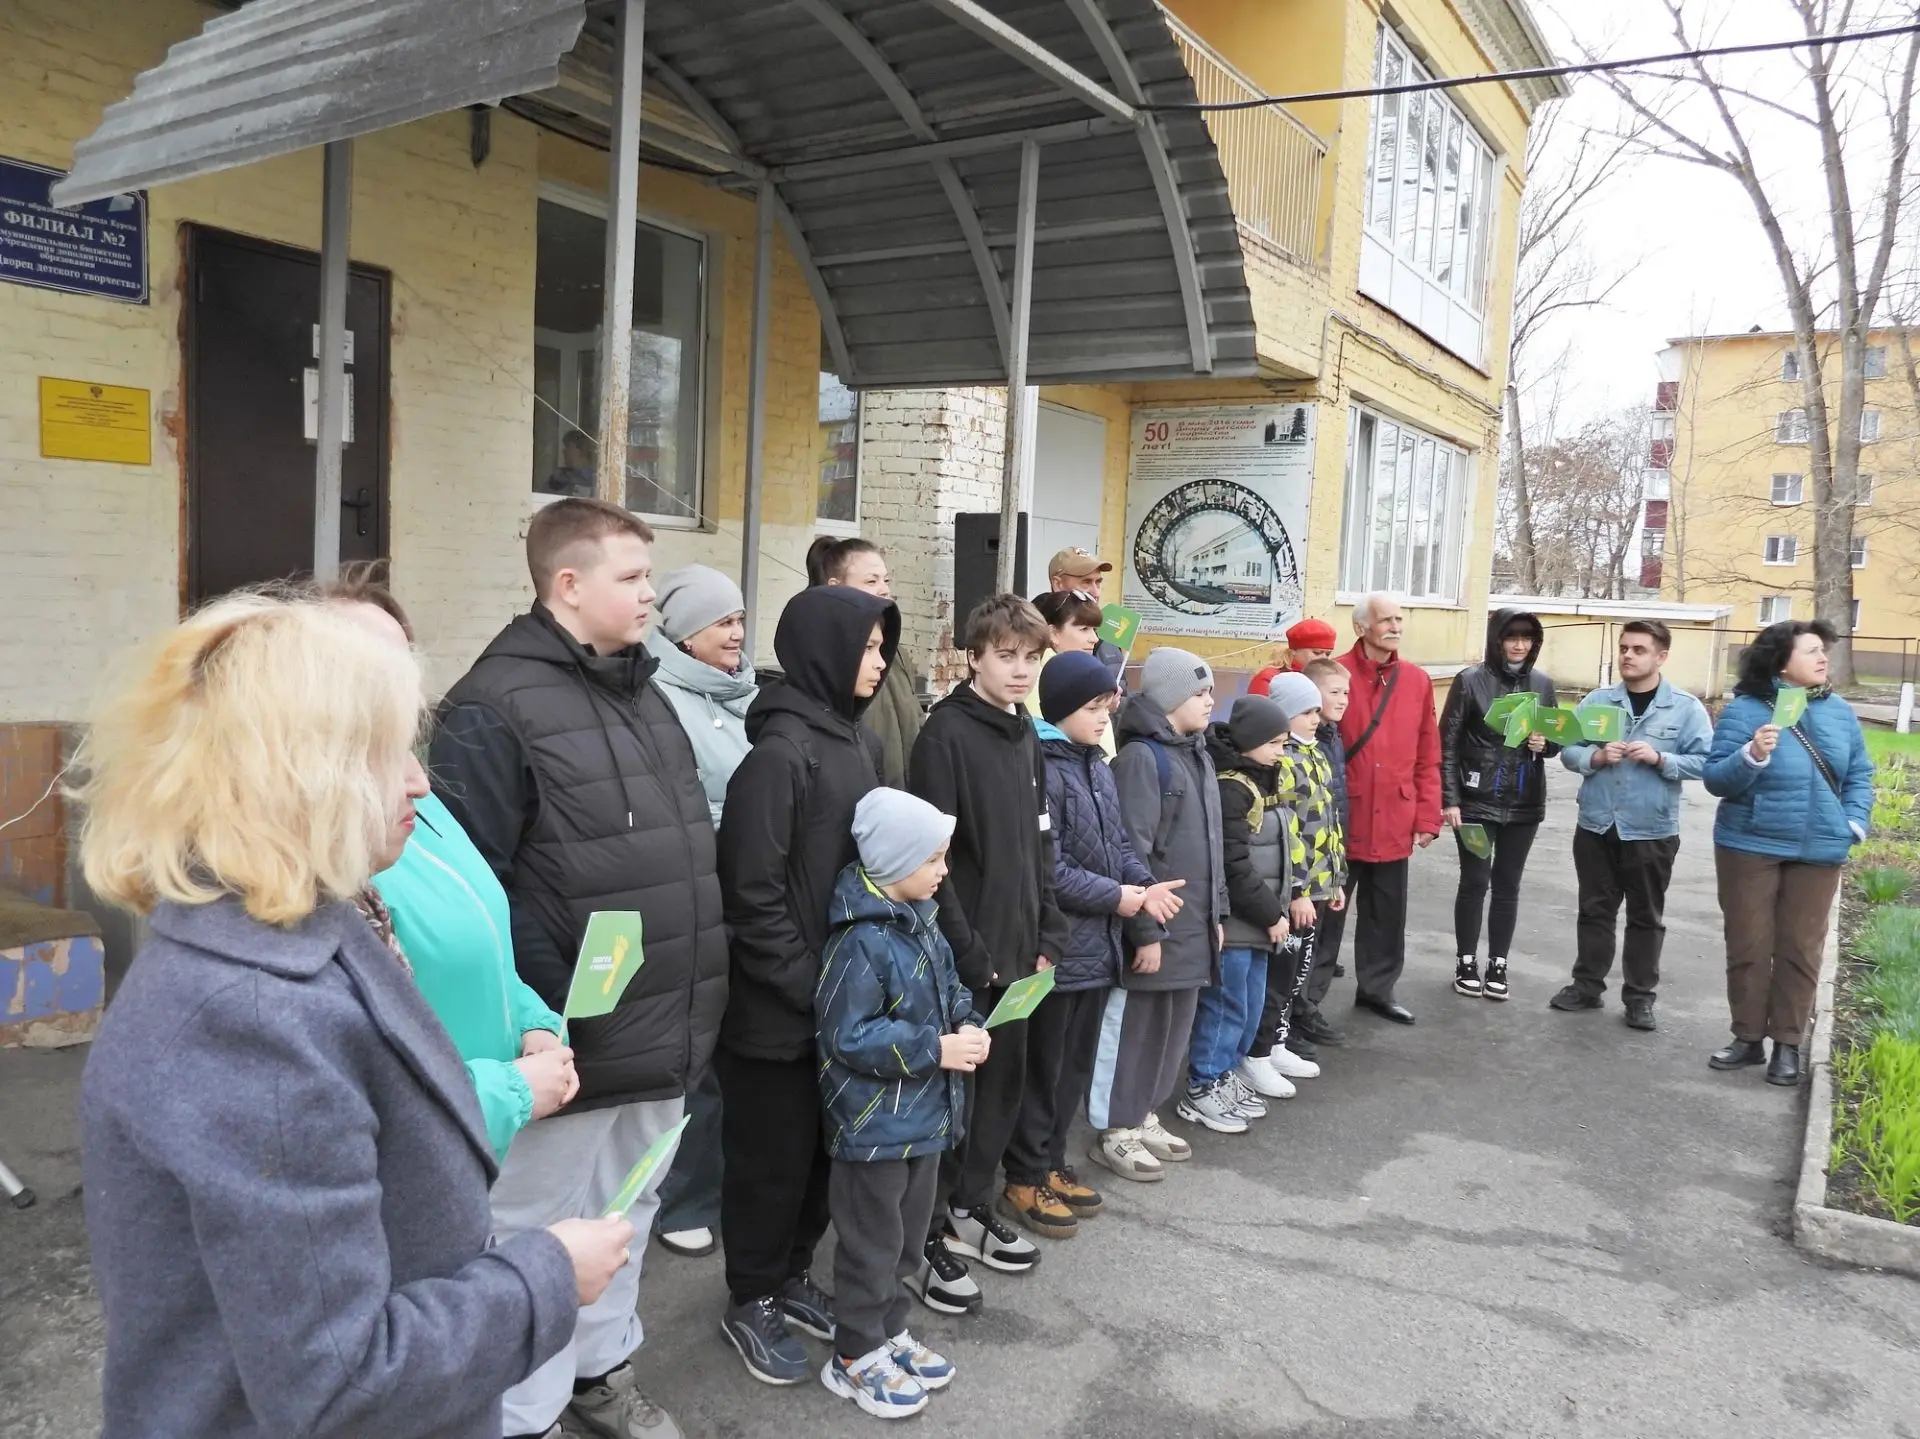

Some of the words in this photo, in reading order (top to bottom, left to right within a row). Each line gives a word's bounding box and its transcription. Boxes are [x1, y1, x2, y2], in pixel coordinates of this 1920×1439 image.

[3, 209, 94, 241] ФИЛИАЛ
[100, 230, 126, 248] №2
[36, 263, 81, 279] детского
[1144, 421, 1170, 442] 50
[1141, 442, 1172, 450] лет!
